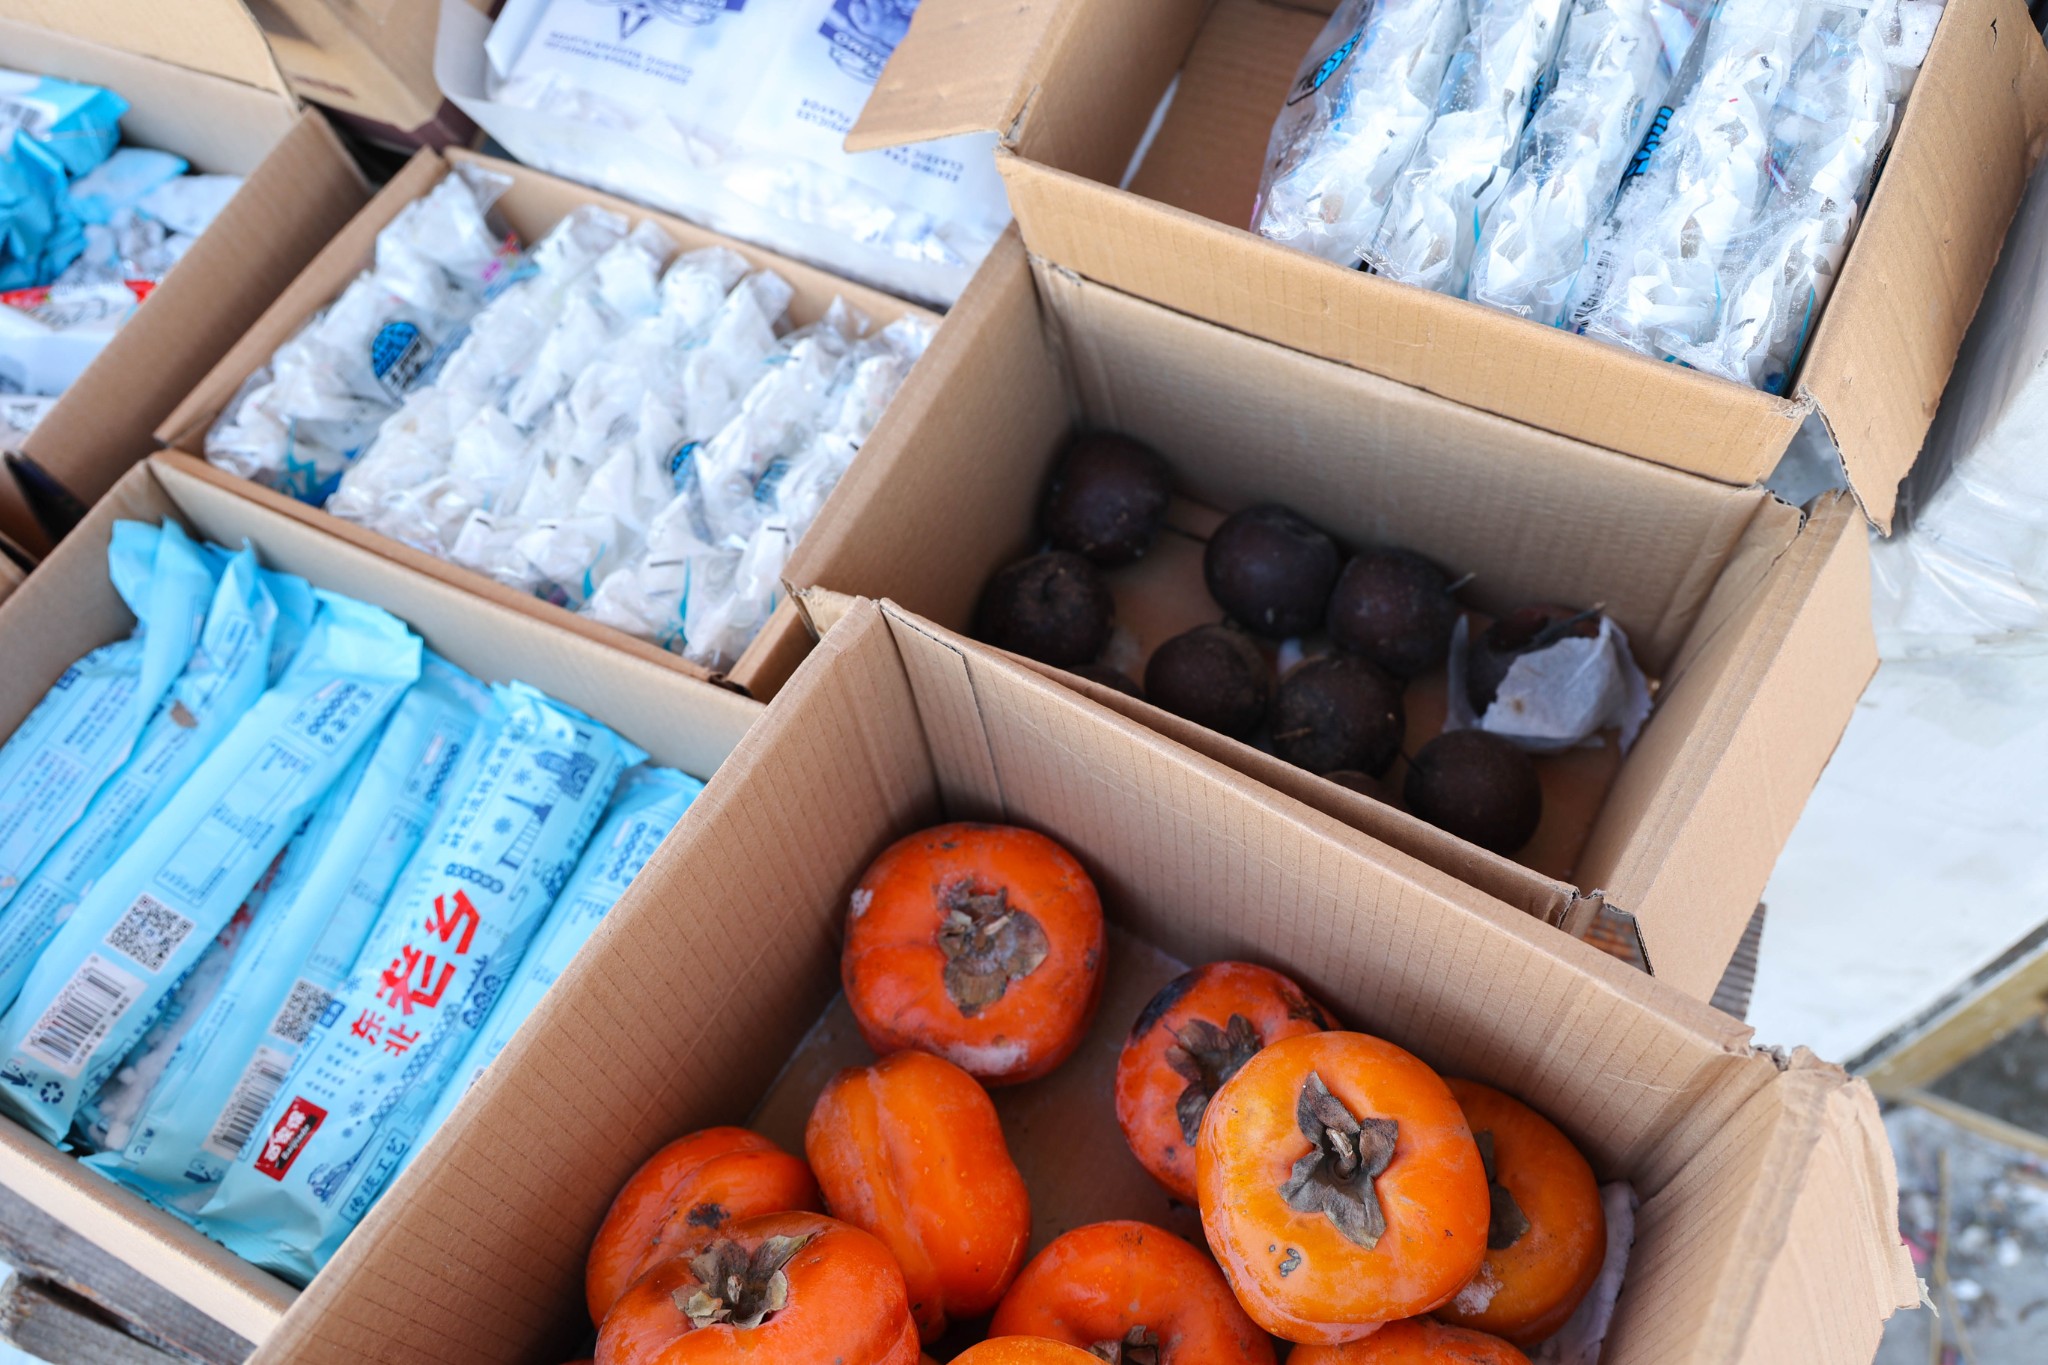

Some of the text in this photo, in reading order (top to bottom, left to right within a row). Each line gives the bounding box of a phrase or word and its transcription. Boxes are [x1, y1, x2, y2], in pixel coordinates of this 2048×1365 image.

[884, 148, 909, 165] CRE
[374, 887, 483, 1015] 老乡
[351, 1004, 421, 1057] 东北
[280, 1122, 311, 1160] Baijiade
[348, 1135, 407, 1215] 传统工艺
